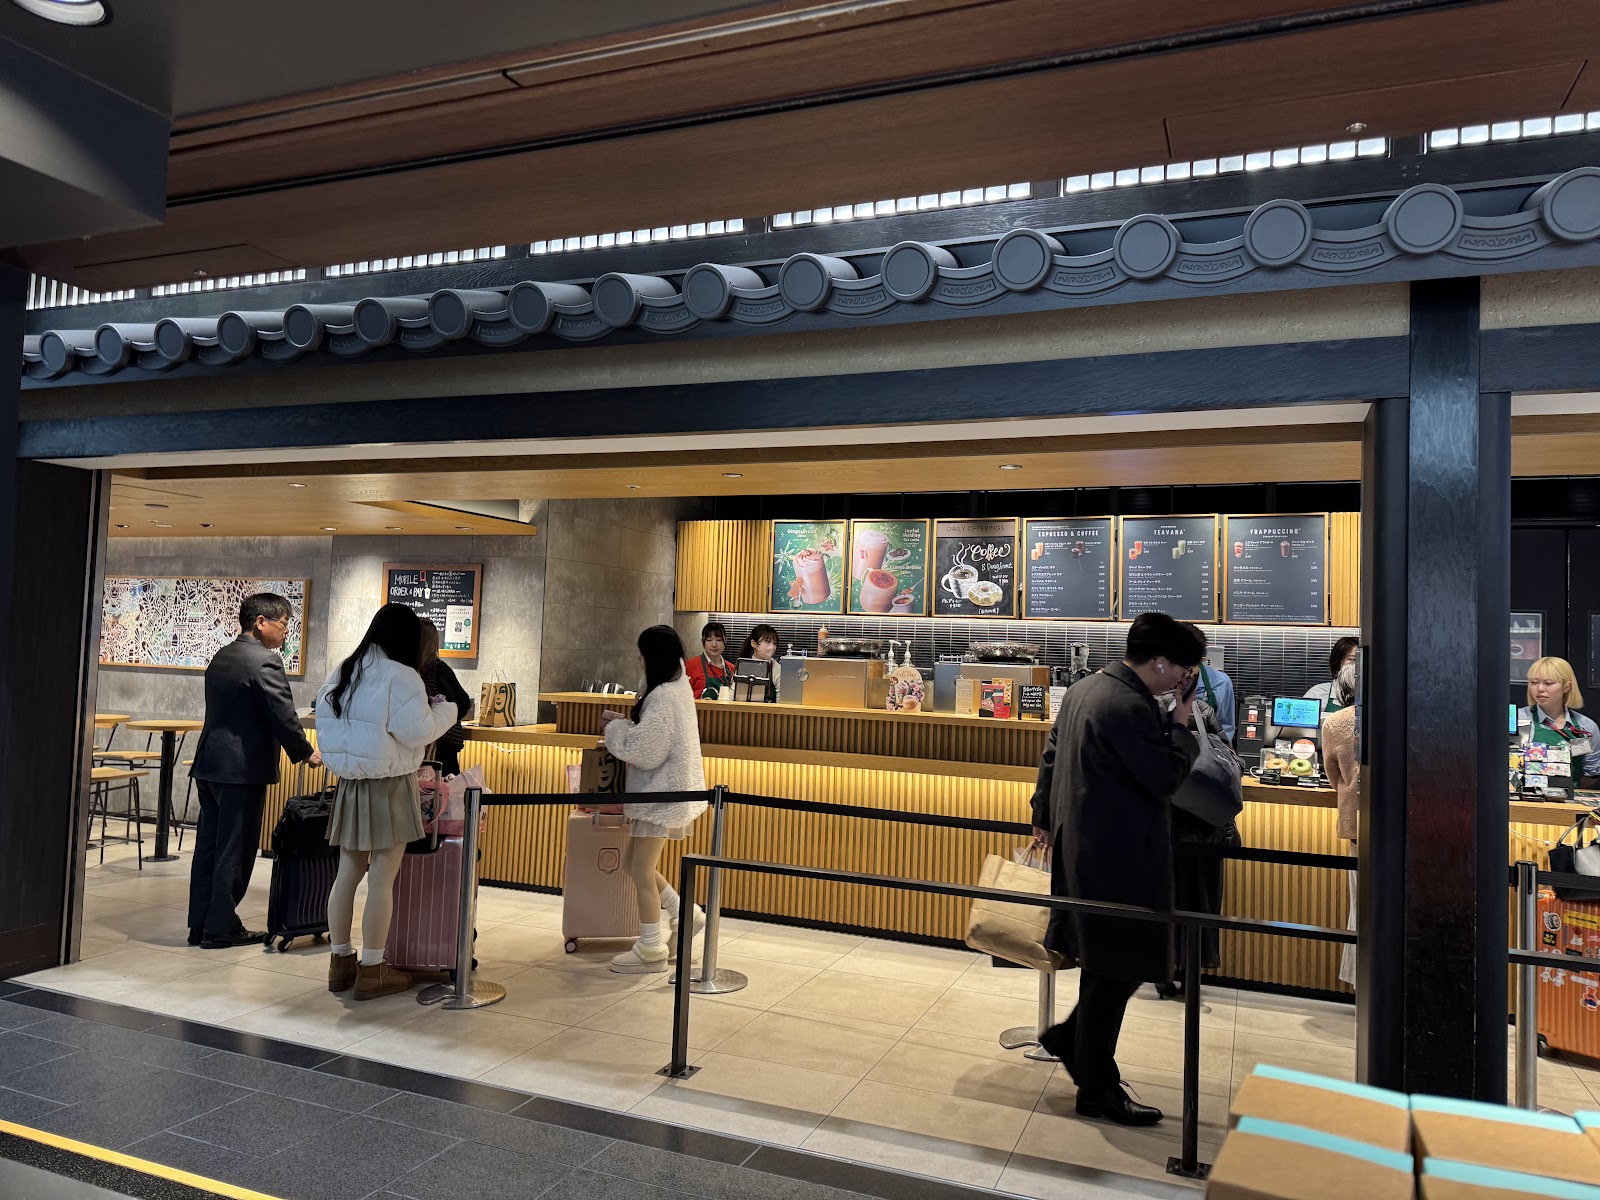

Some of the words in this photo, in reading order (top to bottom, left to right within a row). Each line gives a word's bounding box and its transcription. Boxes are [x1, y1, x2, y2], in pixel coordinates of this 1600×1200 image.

[971, 543, 1011, 562] Coffee
[394, 574, 419, 585] MOBILE
[390, 586, 409, 597] ORDER
[413, 587, 424, 598] PAY
